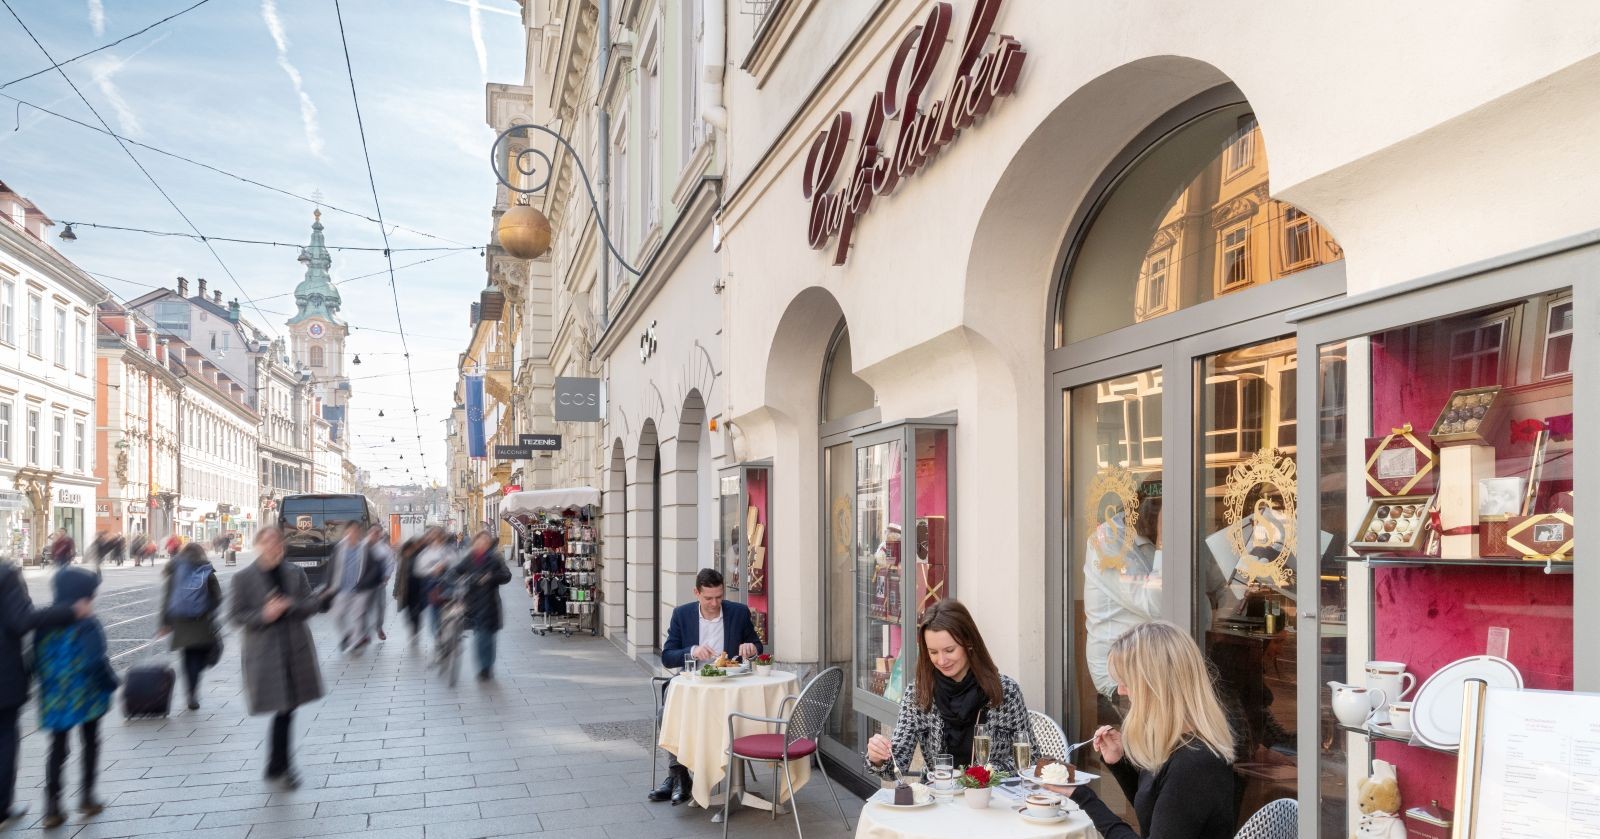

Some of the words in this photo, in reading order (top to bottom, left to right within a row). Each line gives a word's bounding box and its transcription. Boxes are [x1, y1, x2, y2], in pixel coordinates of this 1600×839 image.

[873, 0, 1027, 196] Sacher
[560, 392, 596, 406] COS
[522, 438, 557, 446] TEZENIS
[299, 520, 312, 530] ups
